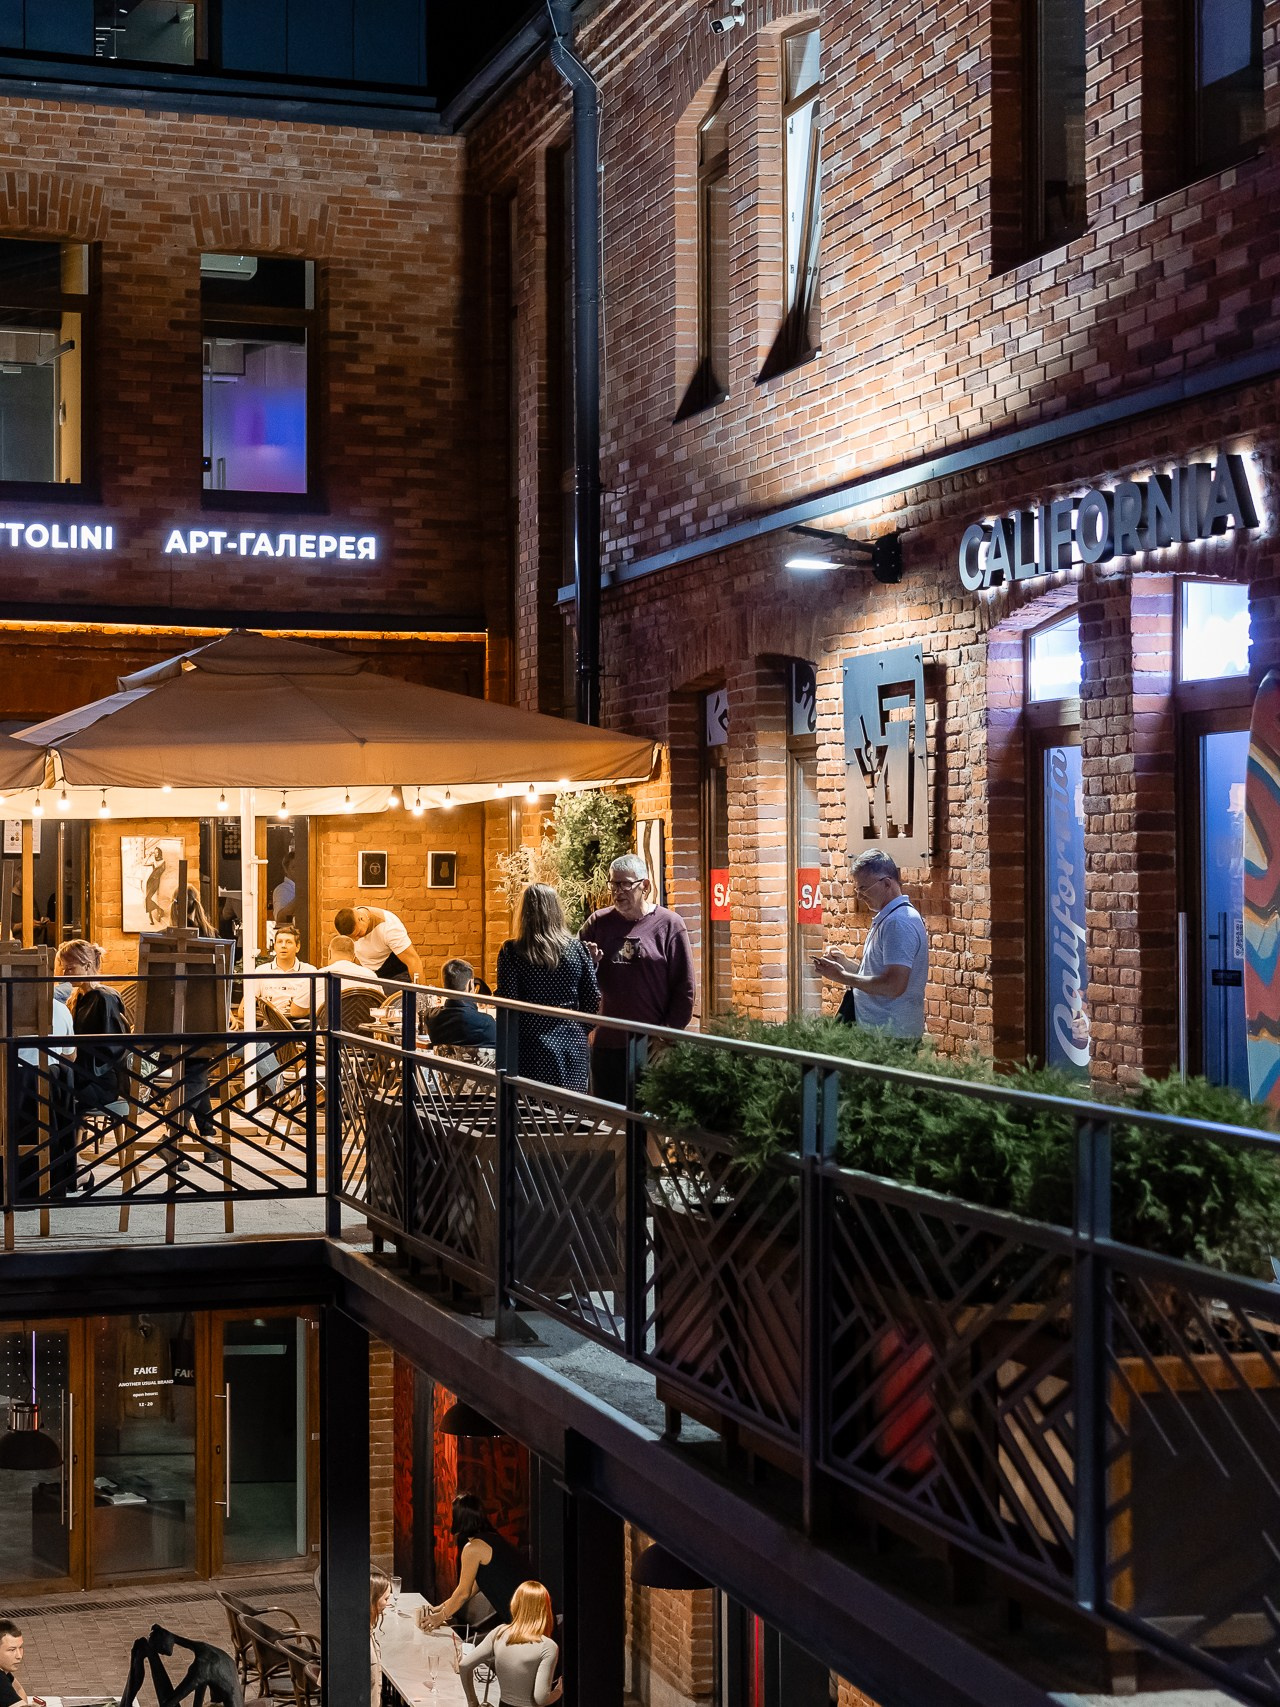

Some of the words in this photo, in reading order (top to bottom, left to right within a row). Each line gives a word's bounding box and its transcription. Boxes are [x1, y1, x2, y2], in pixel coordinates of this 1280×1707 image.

[959, 453, 1258, 592] CALIFORNIA
[165, 530, 375, 559] АРТ-ГАЛЕРЕЯ
[133, 1366, 158, 1376] FAKE
